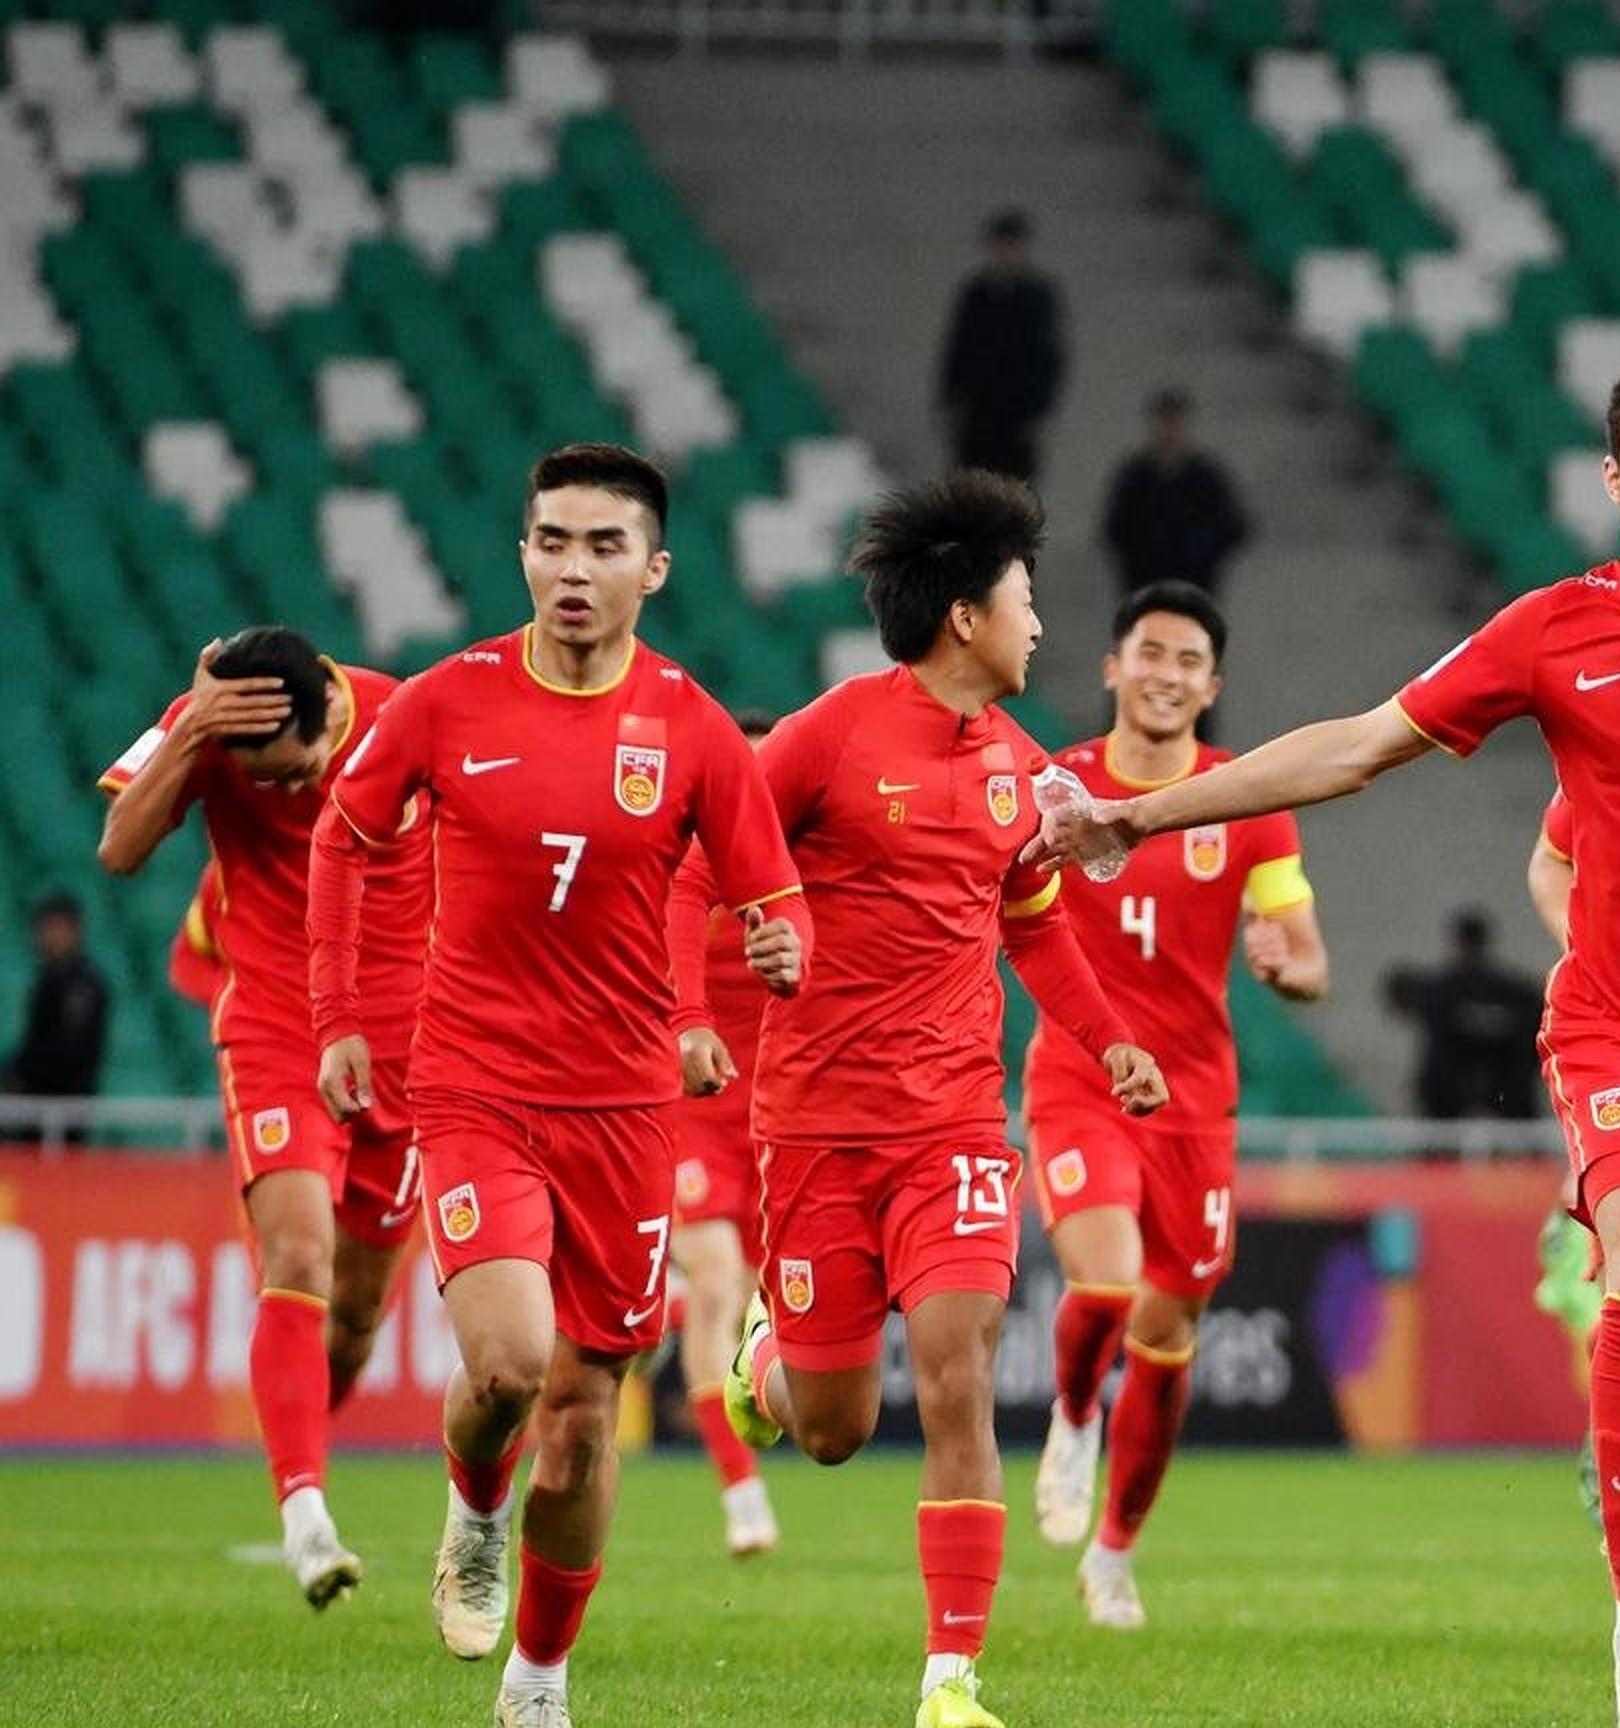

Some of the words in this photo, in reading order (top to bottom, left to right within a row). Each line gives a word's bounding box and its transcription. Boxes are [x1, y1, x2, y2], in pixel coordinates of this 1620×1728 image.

[541, 832, 587, 912] 7
[1120, 895, 1156, 961] 4
[951, 1155, 1011, 1217] 13
[1204, 1187, 1230, 1252] 4
[637, 1214, 669, 1297] 7
